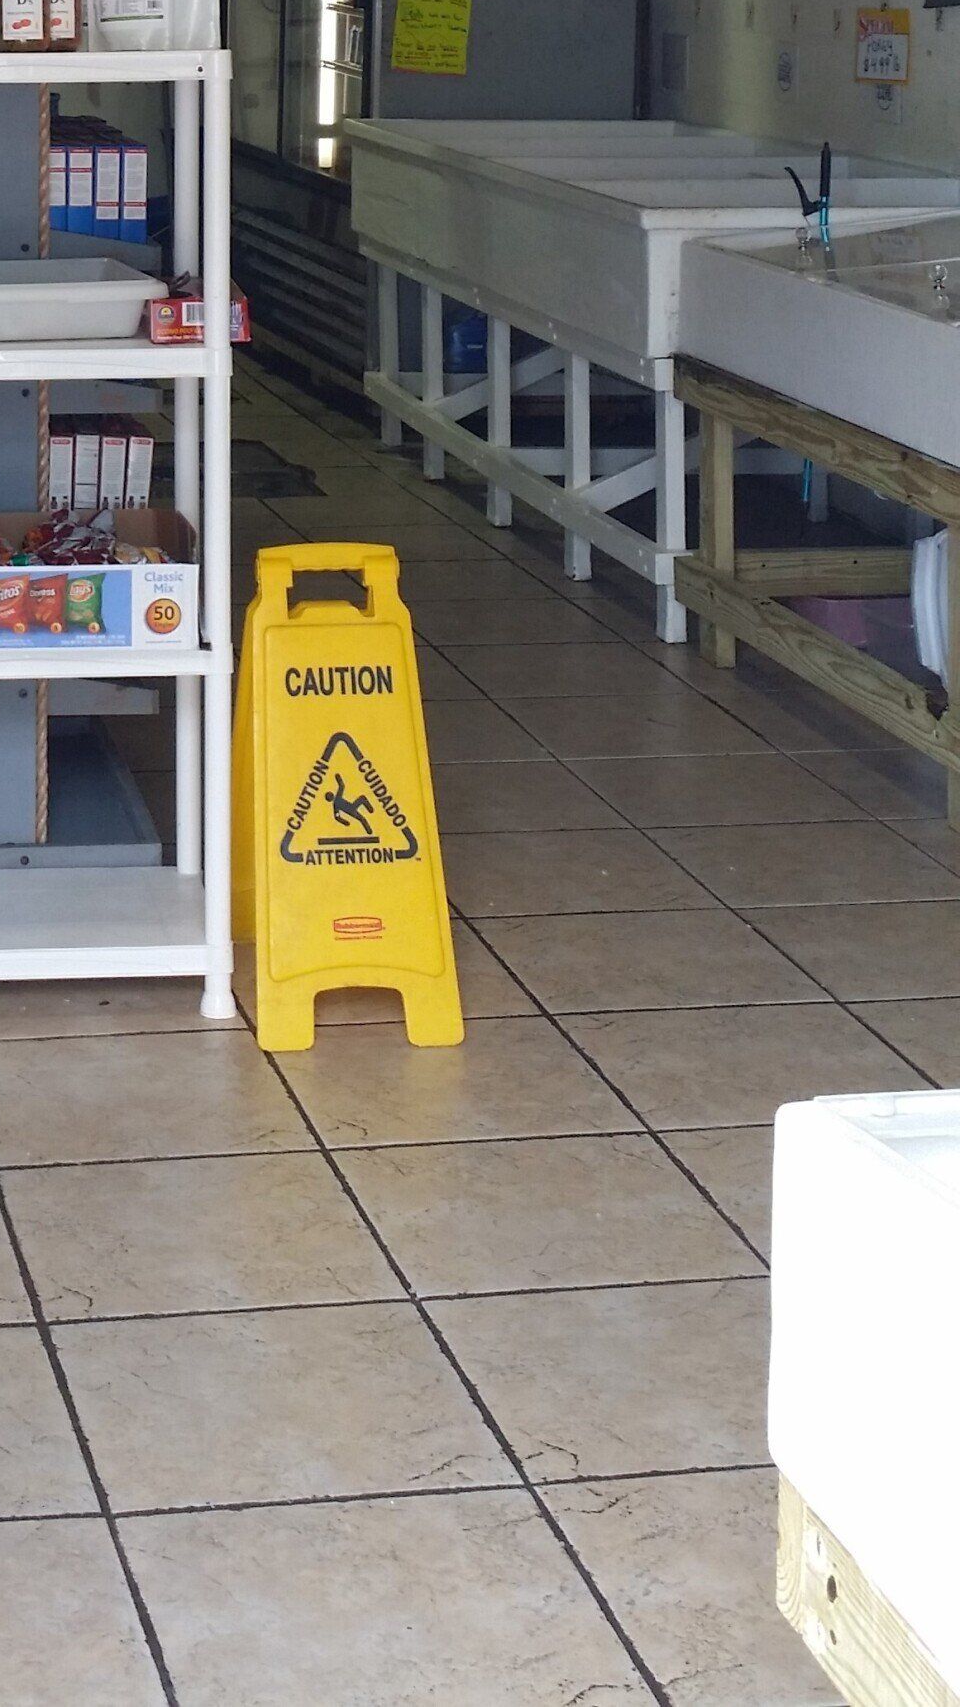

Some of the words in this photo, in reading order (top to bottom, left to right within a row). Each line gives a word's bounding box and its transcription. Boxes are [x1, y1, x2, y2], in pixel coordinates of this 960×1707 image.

[144, 570, 185, 583] Classic
[153, 583, 175, 594] Mix
[153, 605, 175, 621] 50
[285, 665, 394, 696] CAUTION
[287, 760, 330, 831] CAUTION
[358, 759, 407, 828] CUIDADO
[305, 847, 394, 866] ATTENTION
